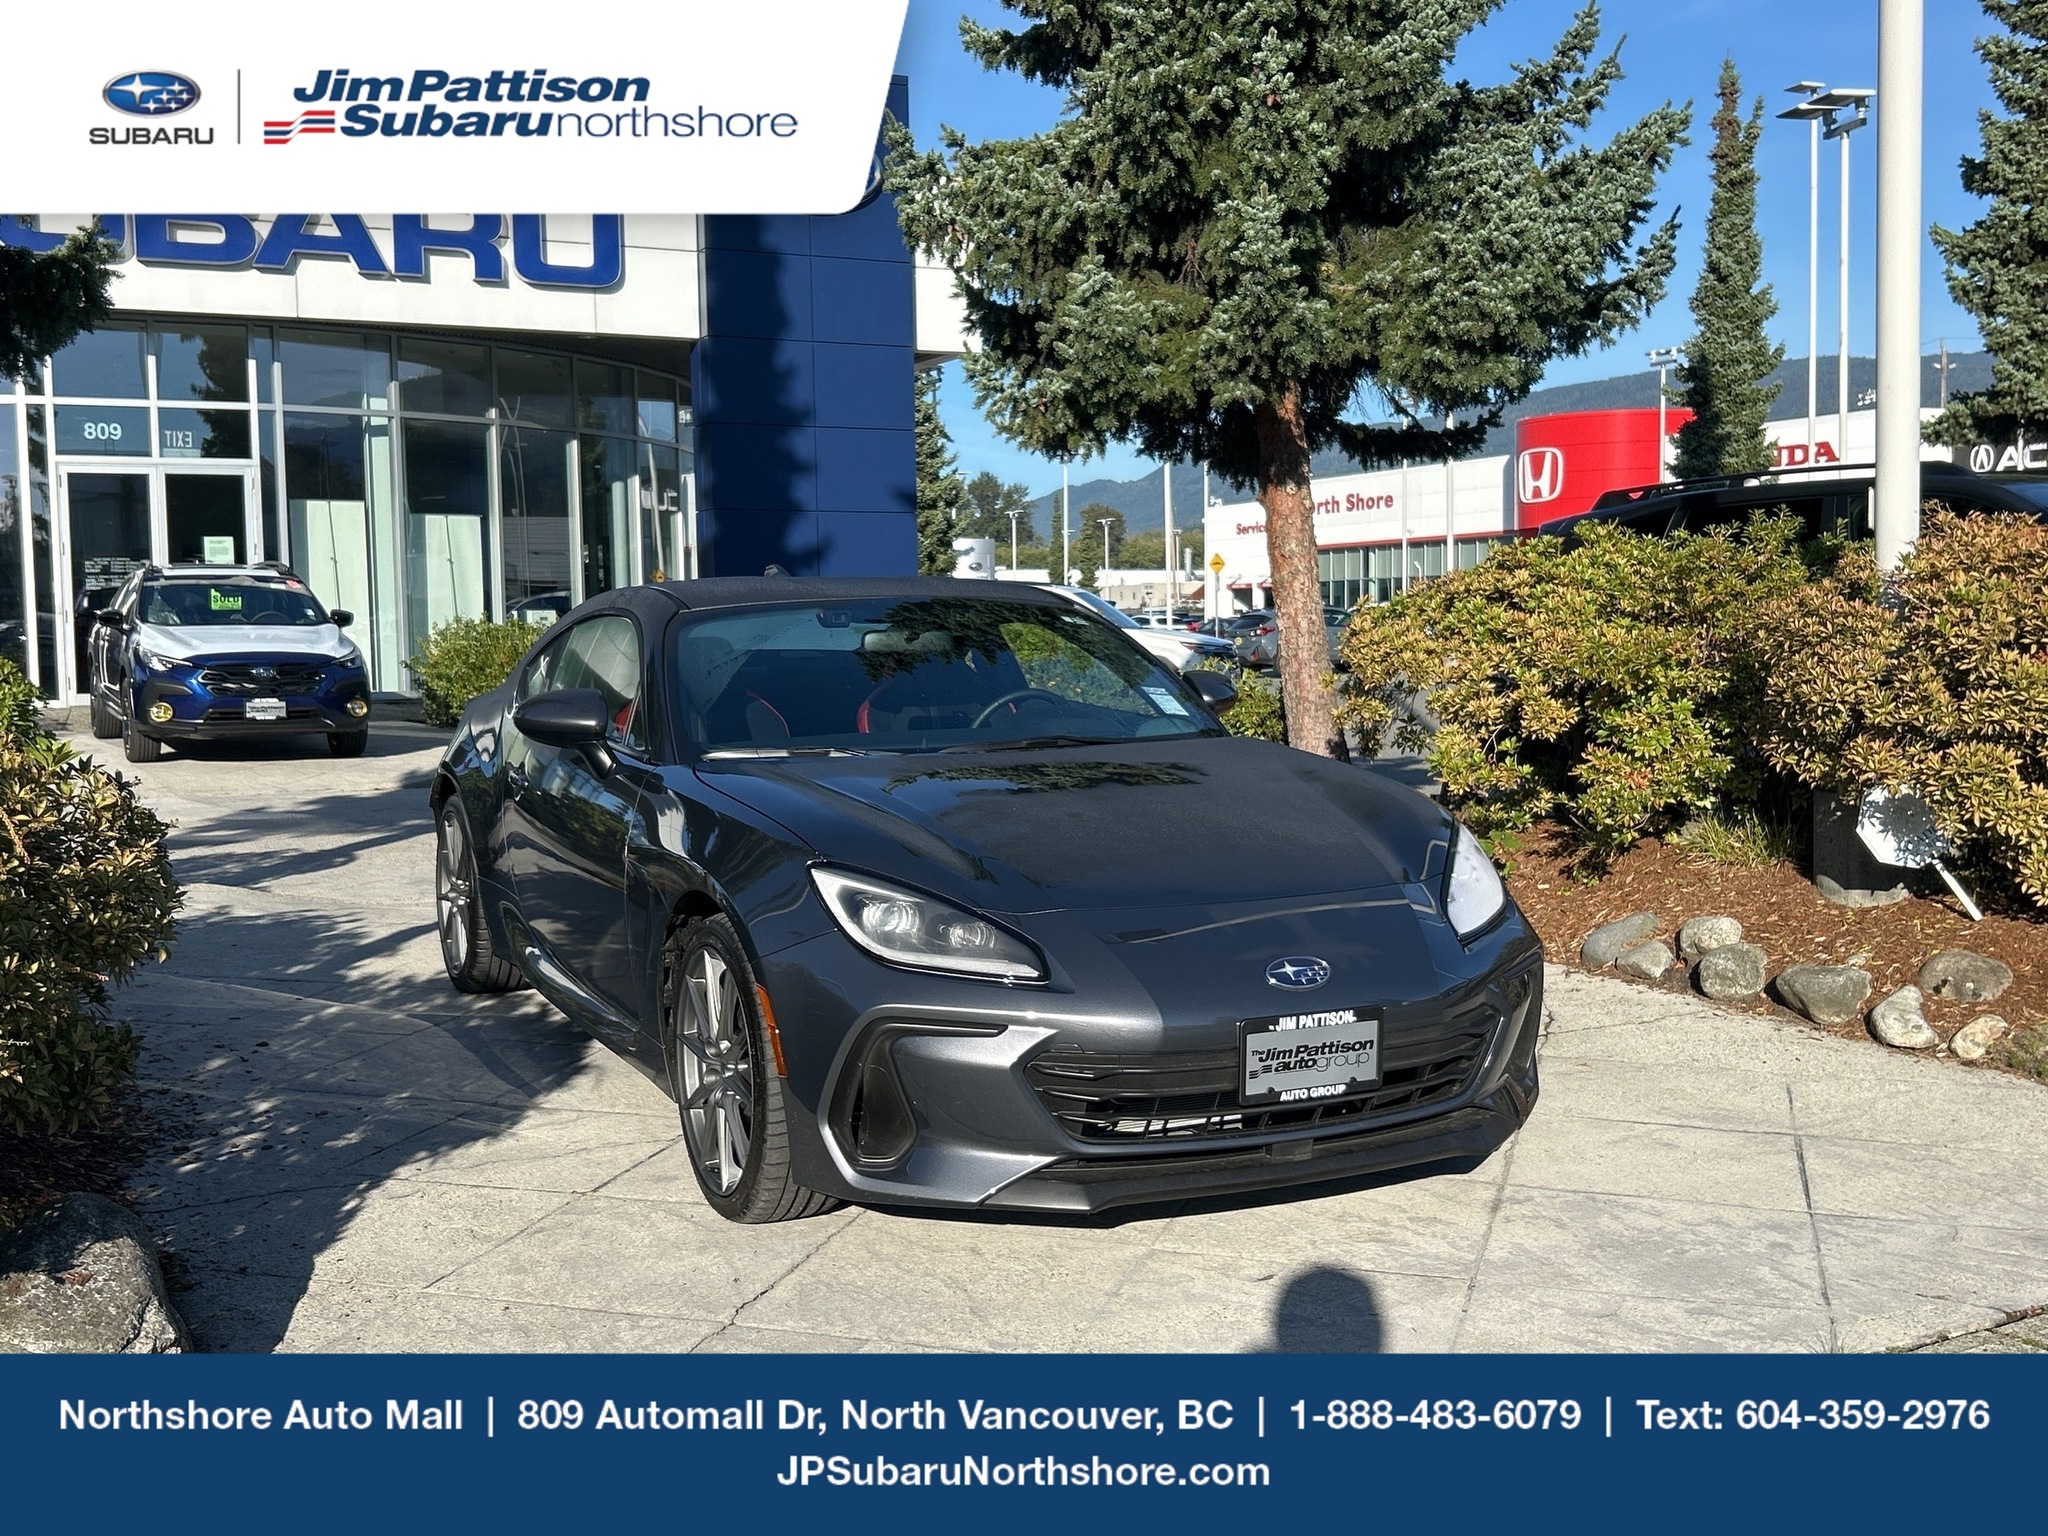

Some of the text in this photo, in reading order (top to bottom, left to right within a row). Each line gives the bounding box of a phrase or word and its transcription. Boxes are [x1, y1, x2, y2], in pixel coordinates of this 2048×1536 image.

[83, 422, 122, 440] 809
[1345, 493, 1394, 513] Shore
[1275, 1009, 1354, 1032] JIM PATTISON
[1251, 1049, 1266, 1057] The
[1279, 1084, 1347, 1102] AUTO GROUP
